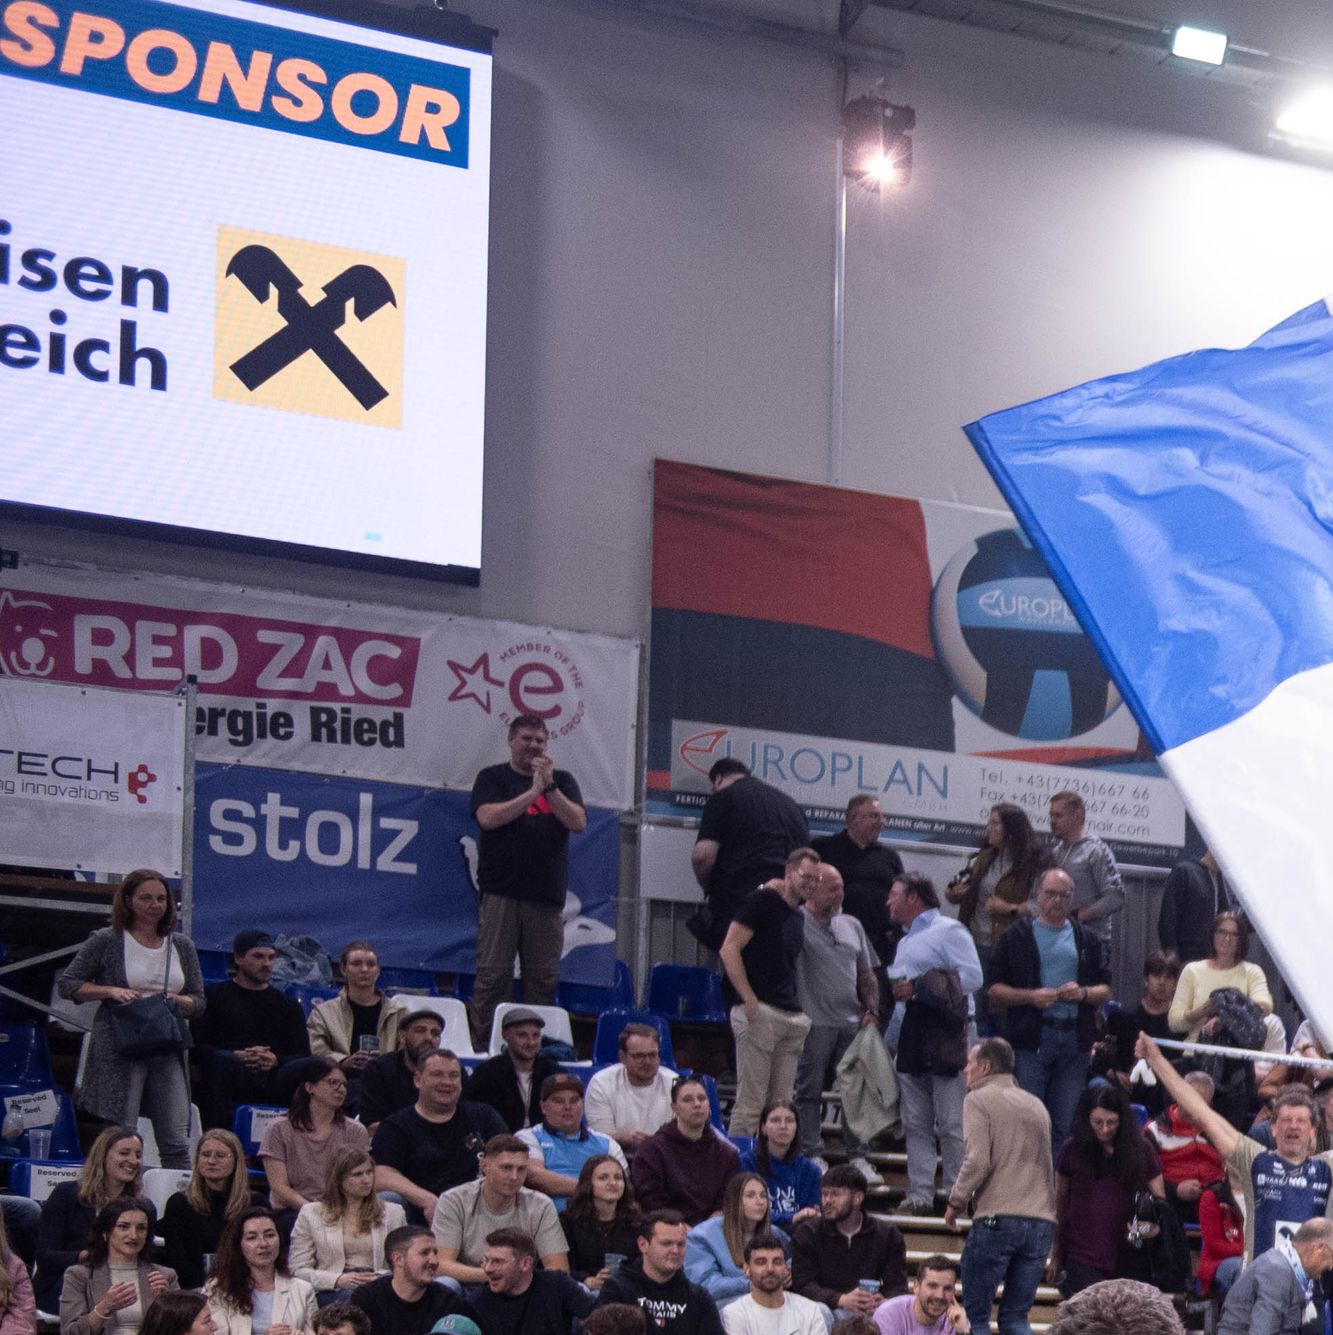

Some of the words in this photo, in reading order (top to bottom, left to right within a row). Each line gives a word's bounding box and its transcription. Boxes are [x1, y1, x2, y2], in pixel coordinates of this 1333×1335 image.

[2, 1, 461, 151] SPONSOR
[74, 613, 239, 684] RED
[257, 630, 405, 700] ZAC
[309, 704, 405, 749] Ried
[22, 781, 120, 803] innovations
[979, 767, 1008, 784] Tel.
[208, 792, 419, 876] stolz
